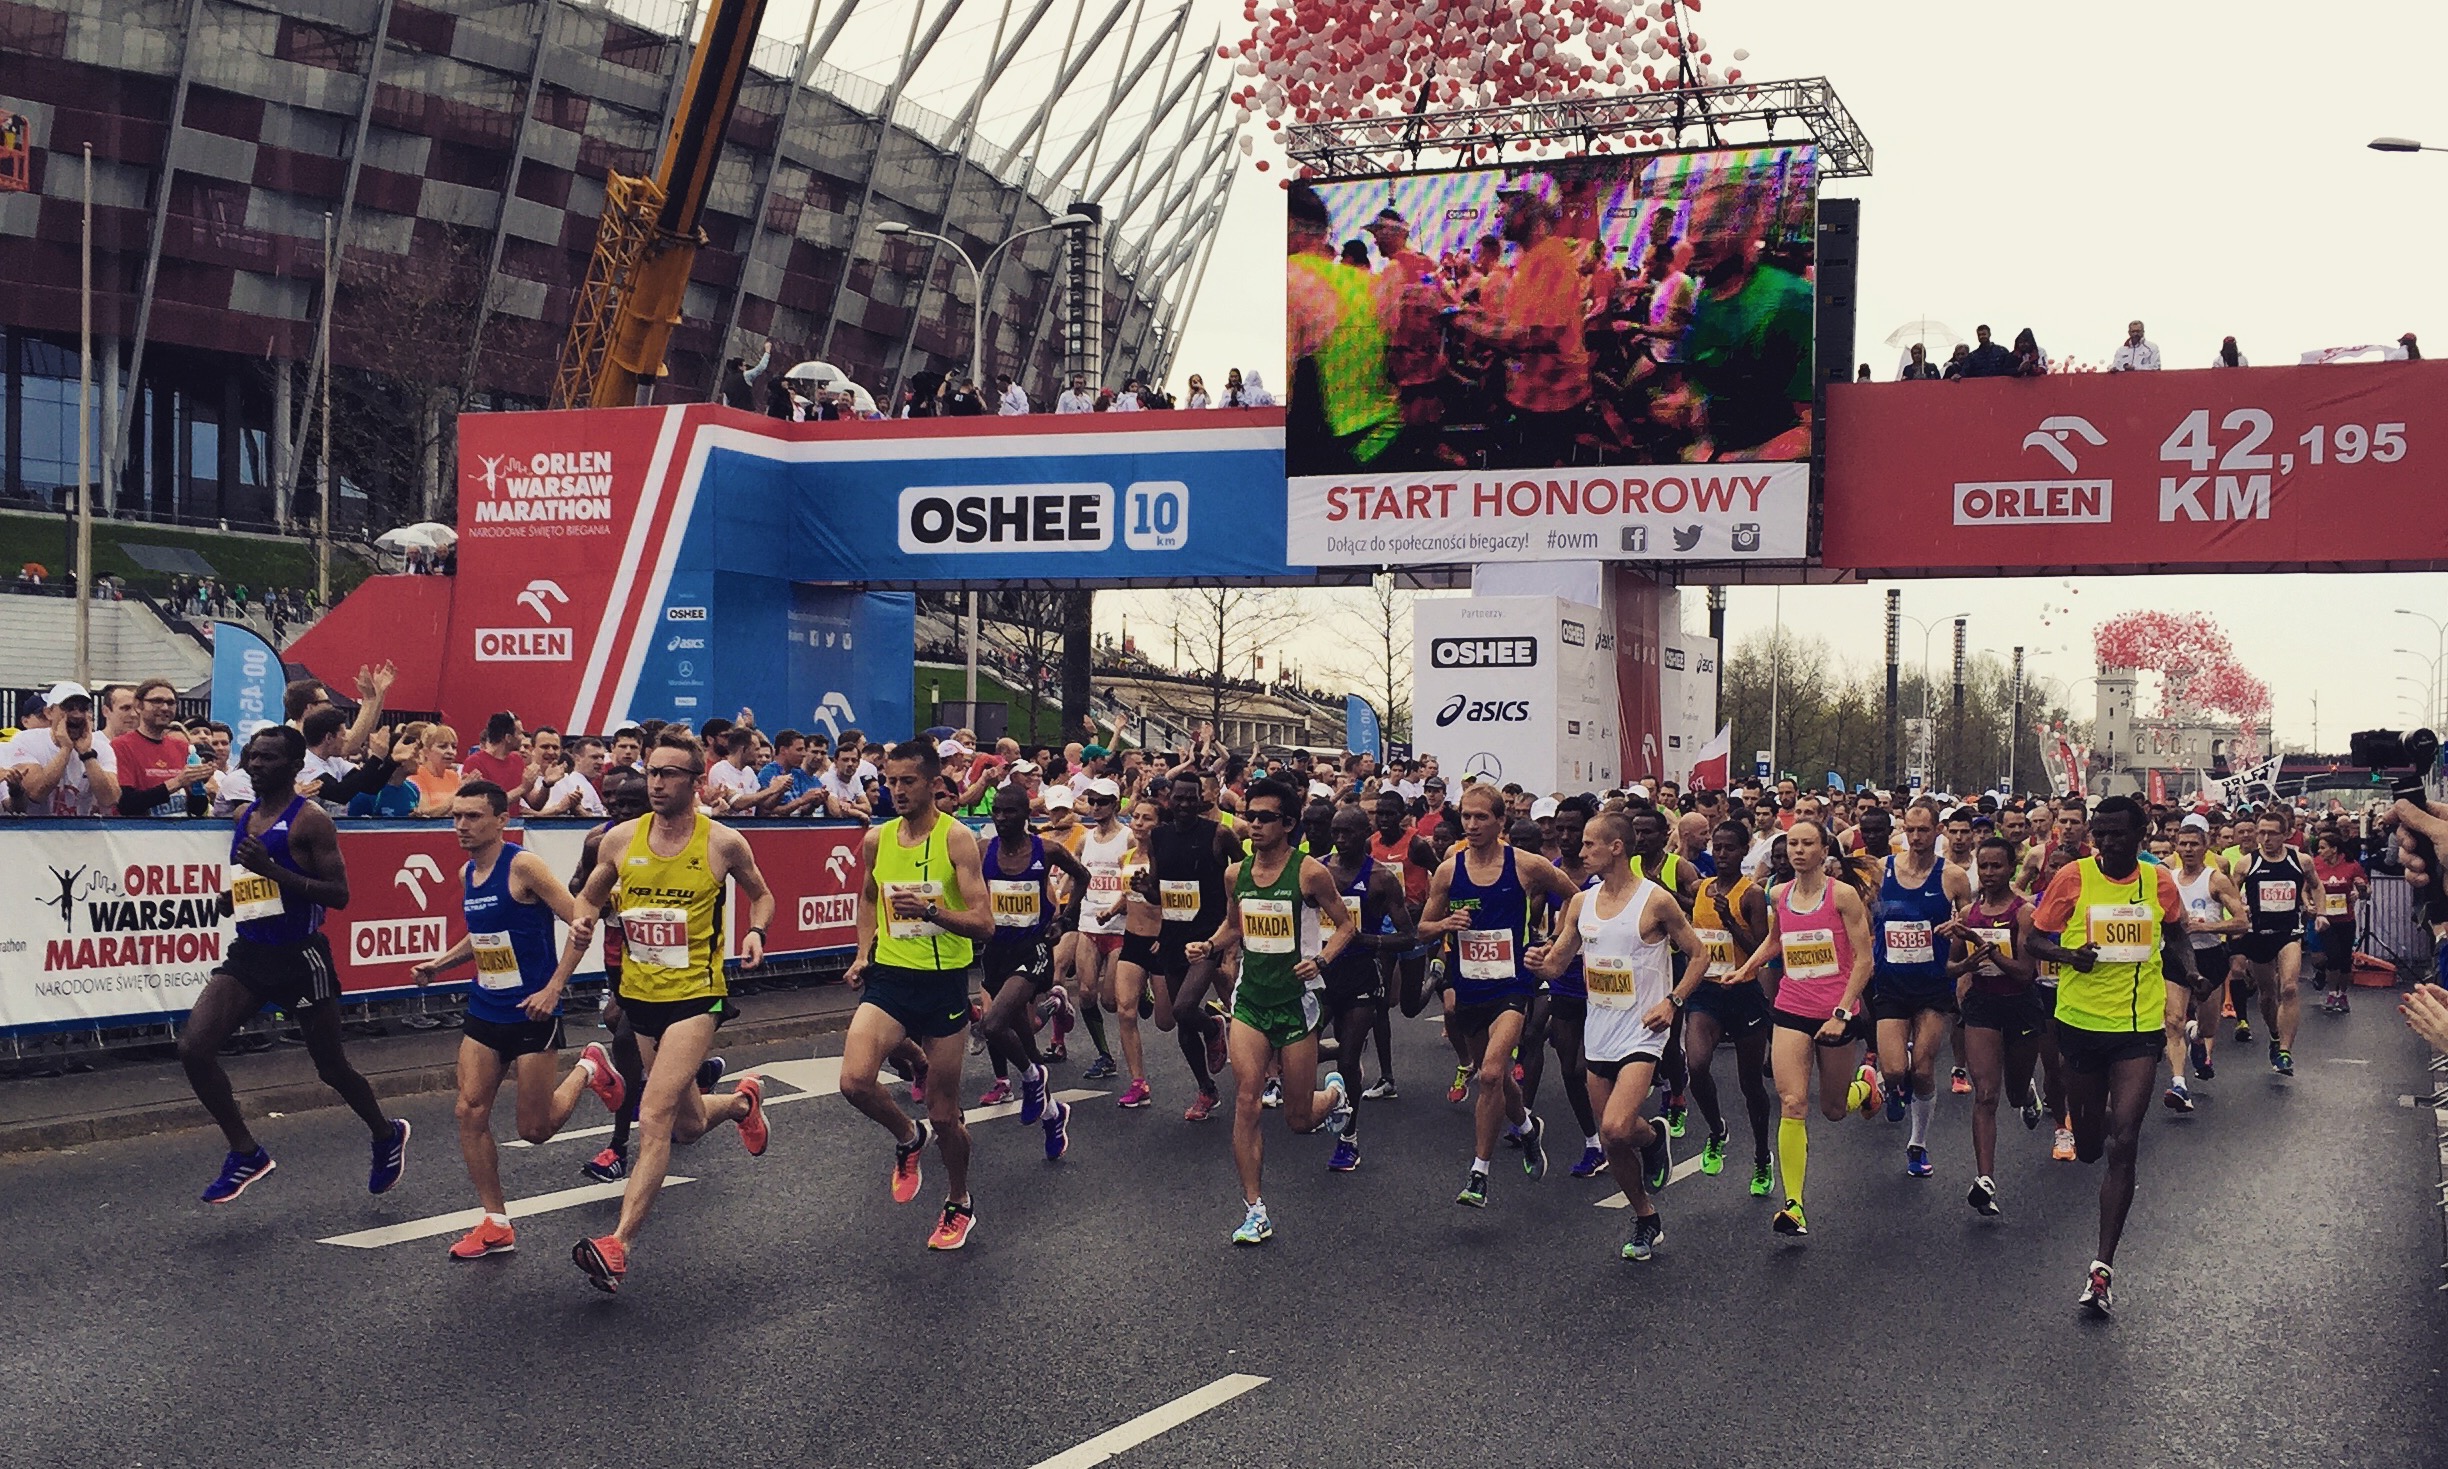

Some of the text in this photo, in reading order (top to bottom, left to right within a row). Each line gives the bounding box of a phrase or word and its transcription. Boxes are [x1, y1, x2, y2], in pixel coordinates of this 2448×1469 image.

[2160, 408, 2407, 474] 42,195
[531, 452, 611, 475] ORLEN
[507, 475, 613, 499] WARSAW
[1326, 476, 1772, 521] START HONOROWY
[2159, 475, 2271, 522] KM
[476, 498, 611, 522] MARATHON
[1134, 491, 1179, 535] 10
[1962, 487, 2101, 518] ORLEN
[910, 495, 1100, 543] OSHEE
[469, 524, 611, 539] NARODOWE ŚWIĘTO BIEGANIA
[1156, 535, 1175, 546] km
[1327, 530, 1598, 555] Dołącz do społeczności biegaczy! #owm
[669, 610, 704, 619] OSHEE
[481, 634, 565, 655] ORLEN
[1437, 641, 1532, 665] OSHEE
[1466, 701, 1529, 722] asics
[124, 864, 221, 897] ORLEN
[1090, 876, 1118, 890] 6310
[803, 899, 853, 925] ORLEN
[997, 895, 1033, 913] KITUR
[1166, 893, 1192, 908] NEMO
[89, 899, 221, 933] WARSAW
[1245, 915, 1290, 936] TAKADA
[356, 924, 440, 956] ORLEN
[630, 922, 676, 945] 2161
[1890, 932, 1927, 948] 5385
[2106, 923, 2141, 944] SORI
[44, 932, 220, 971] MARATHON
[1469, 942, 1499, 960] 525
[35, 976, 112, 997] NARODOWE
[116, 973, 160, 993] ŚWIĘTO
